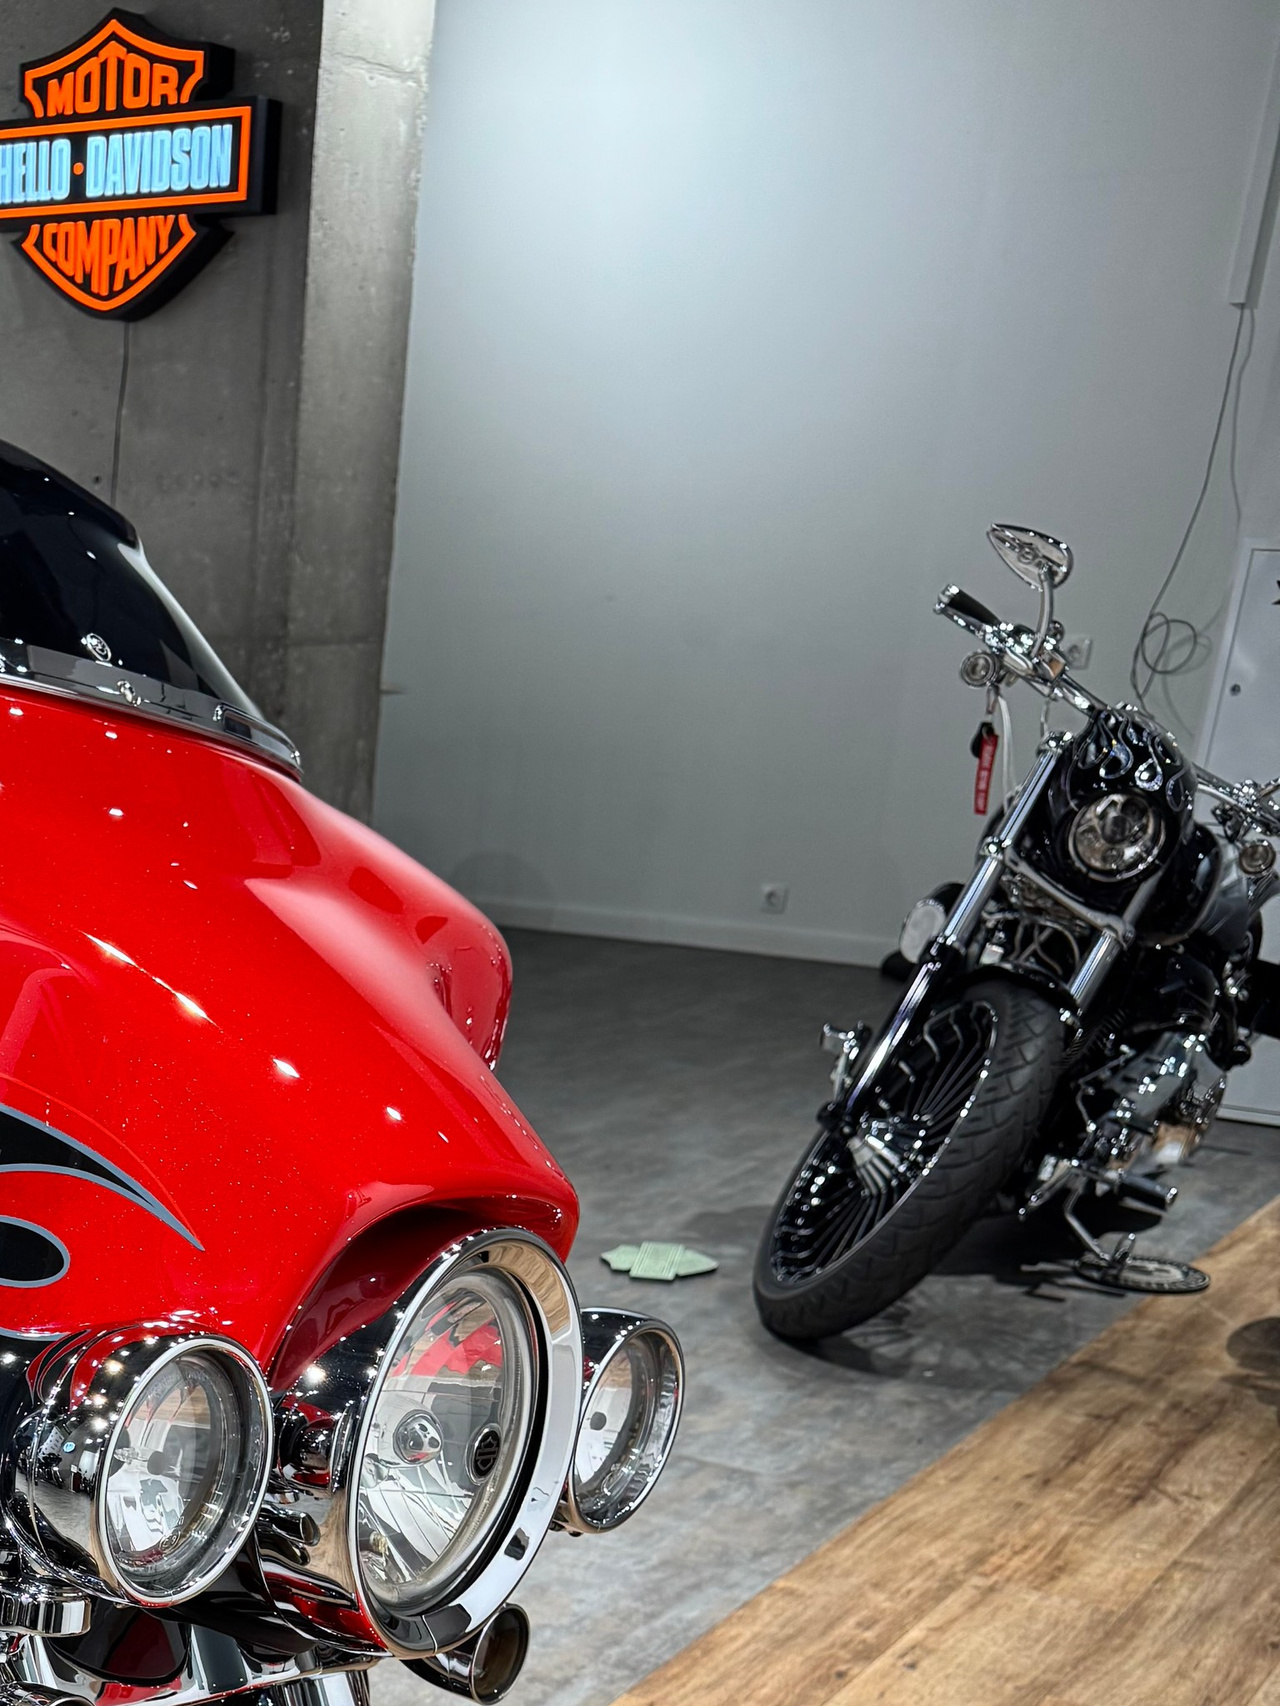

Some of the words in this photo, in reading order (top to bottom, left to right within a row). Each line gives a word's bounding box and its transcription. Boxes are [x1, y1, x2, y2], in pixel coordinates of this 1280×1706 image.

[46, 40, 179, 117] MOTOR
[86, 124, 233, 198] DAVIDSON
[43, 214, 175, 296] COMPANY
